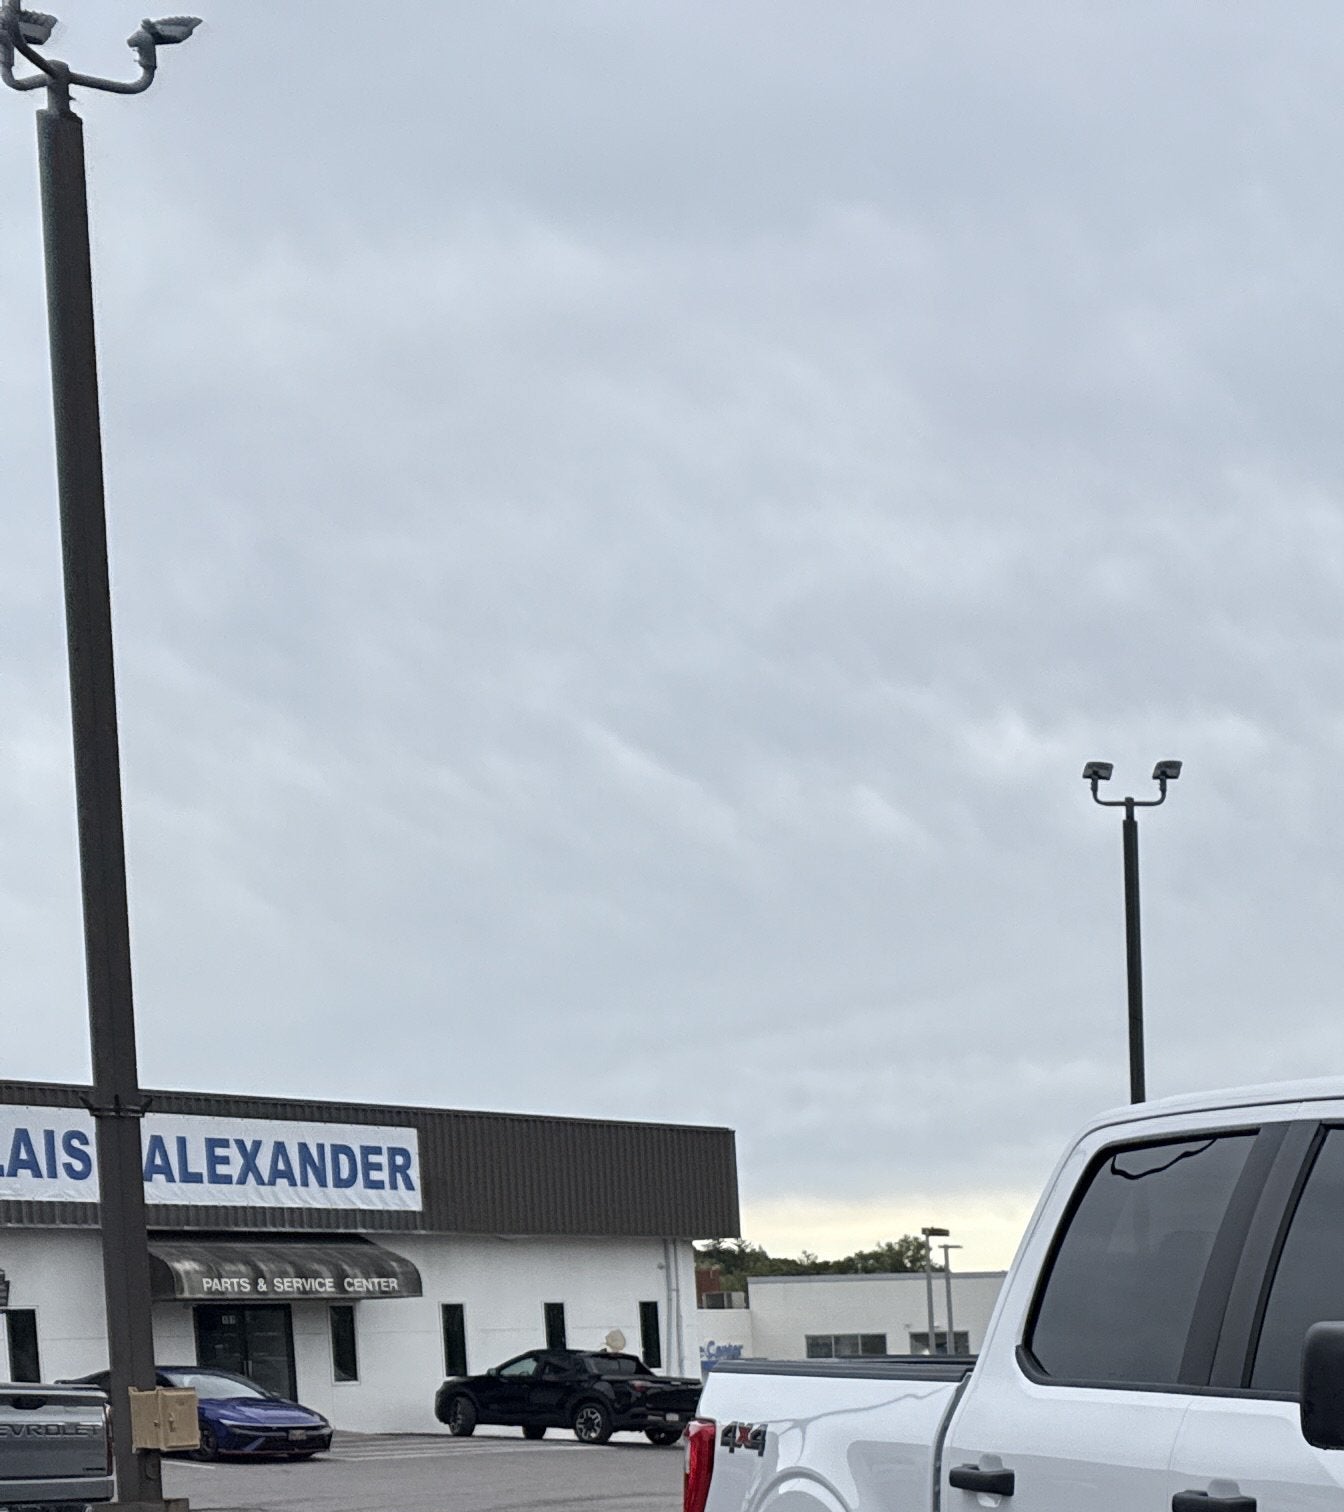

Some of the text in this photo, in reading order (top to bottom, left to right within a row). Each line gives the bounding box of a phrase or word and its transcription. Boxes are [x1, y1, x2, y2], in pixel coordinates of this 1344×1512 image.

[0, 1127, 415, 1191] AIS ALEXANDER
[202, 1277, 399, 1292] PARTS & SERVICE CENTER
